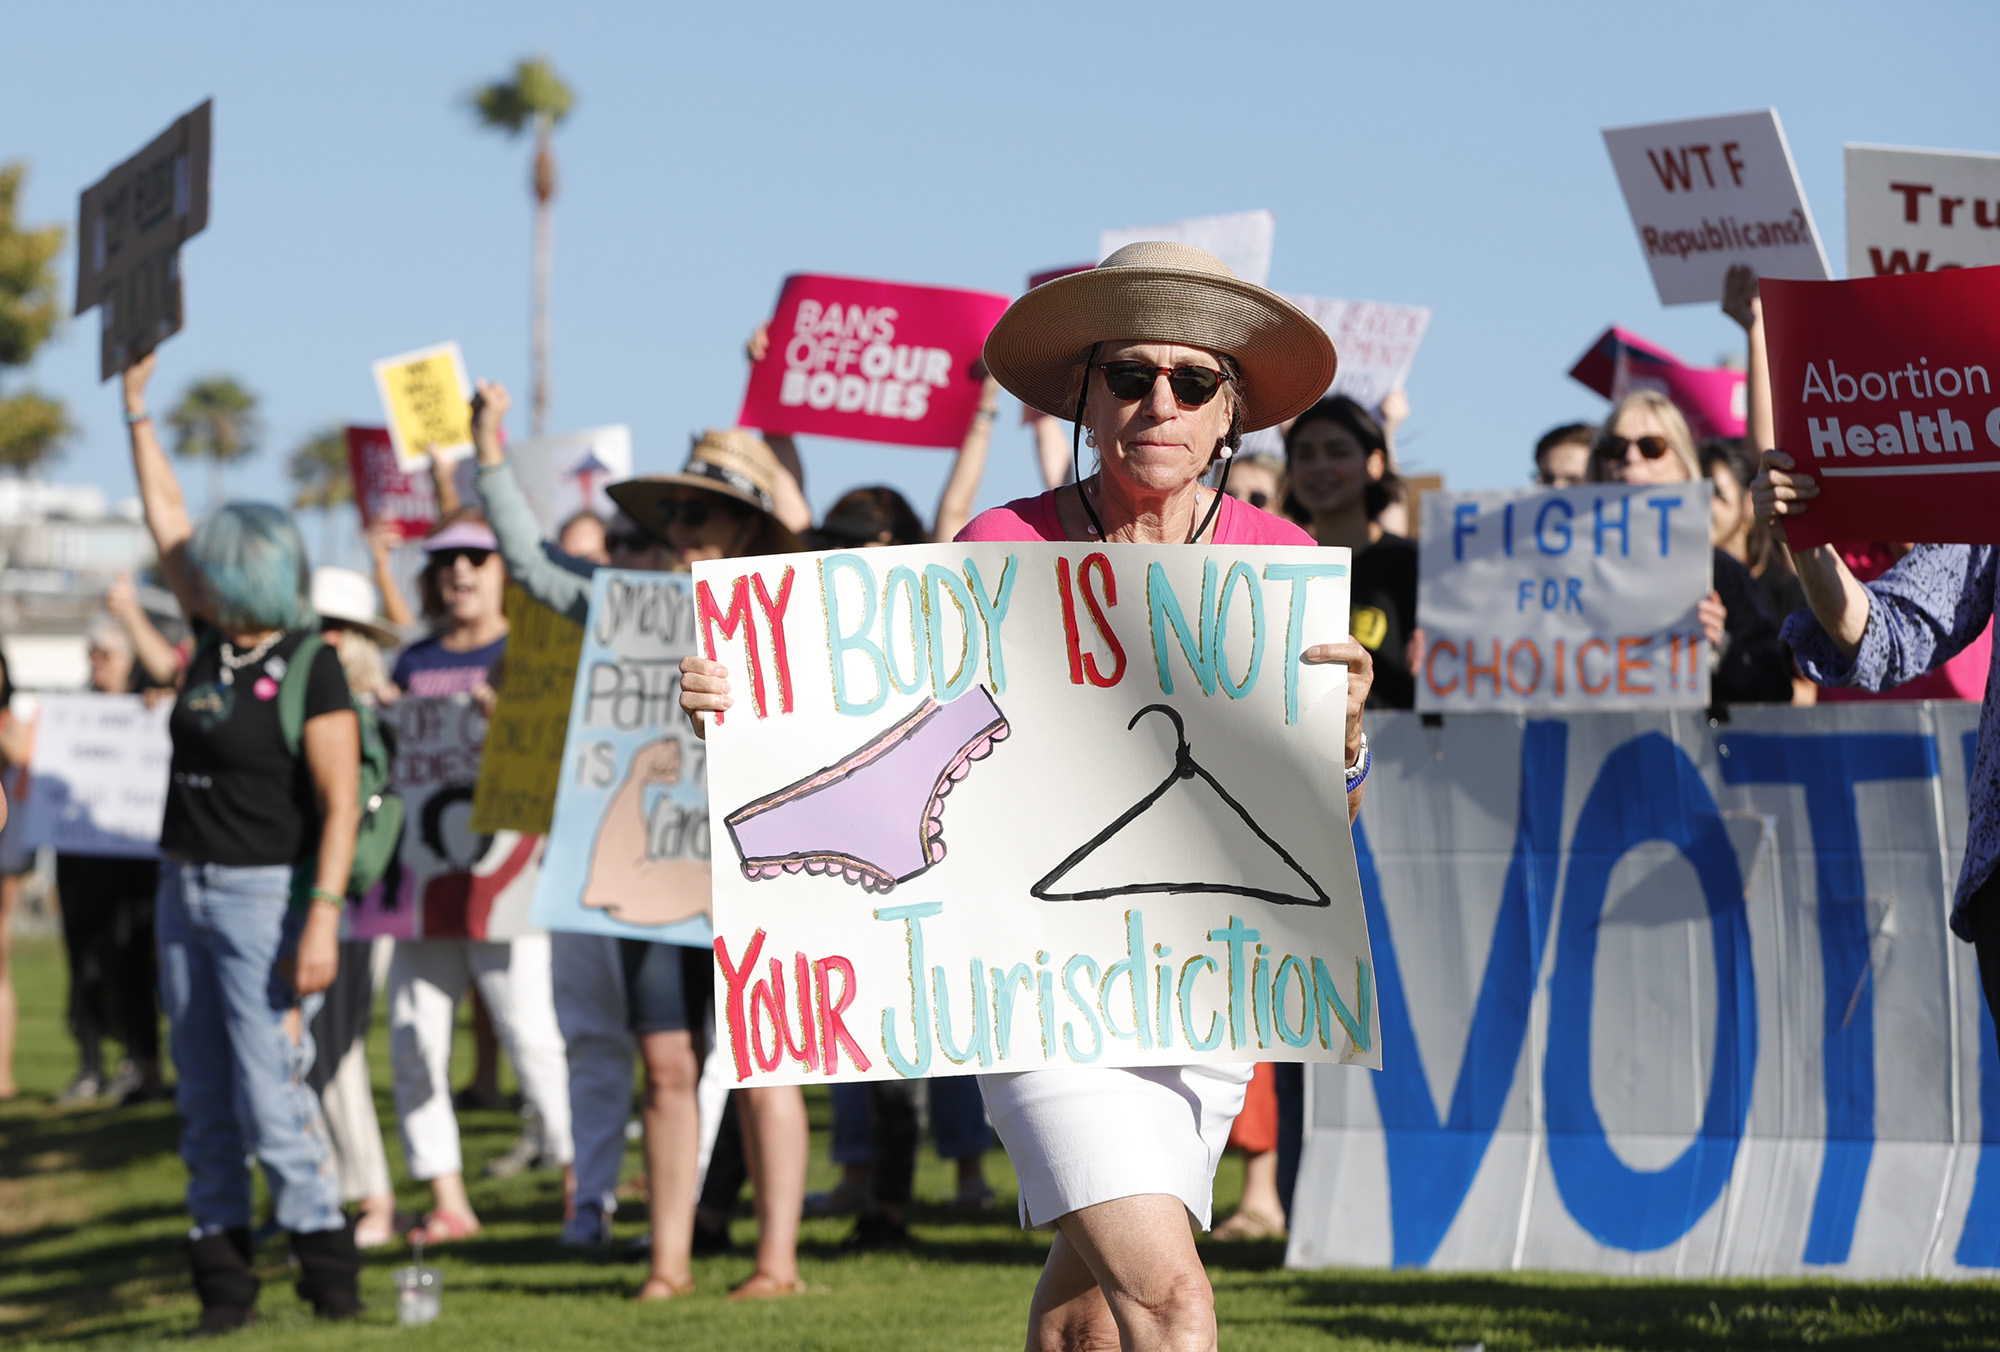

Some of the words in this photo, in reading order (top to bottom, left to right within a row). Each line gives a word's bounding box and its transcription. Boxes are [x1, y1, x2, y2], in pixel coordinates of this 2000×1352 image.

[1646, 141, 1746, 193] WTF
[1641, 206, 1809, 263] Republicans?
[793, 299, 899, 344] BANS
[779, 368, 931, 421] BODIES
[1802, 357, 1990, 403] Abortion
[1806, 408, 1974, 458] Health
[1452, 496, 1683, 563] FIGHT
[1516, 577, 1584, 613] FOR
[695, 563, 795, 727] MY
[816, 553, 1019, 718] BODY
[1057, 552, 1128, 688] IS
[1148, 559, 1349, 726] NOT
[1425, 633, 1699, 697] CHOICE!!
[1353, 720, 2000, 1271] VOT
